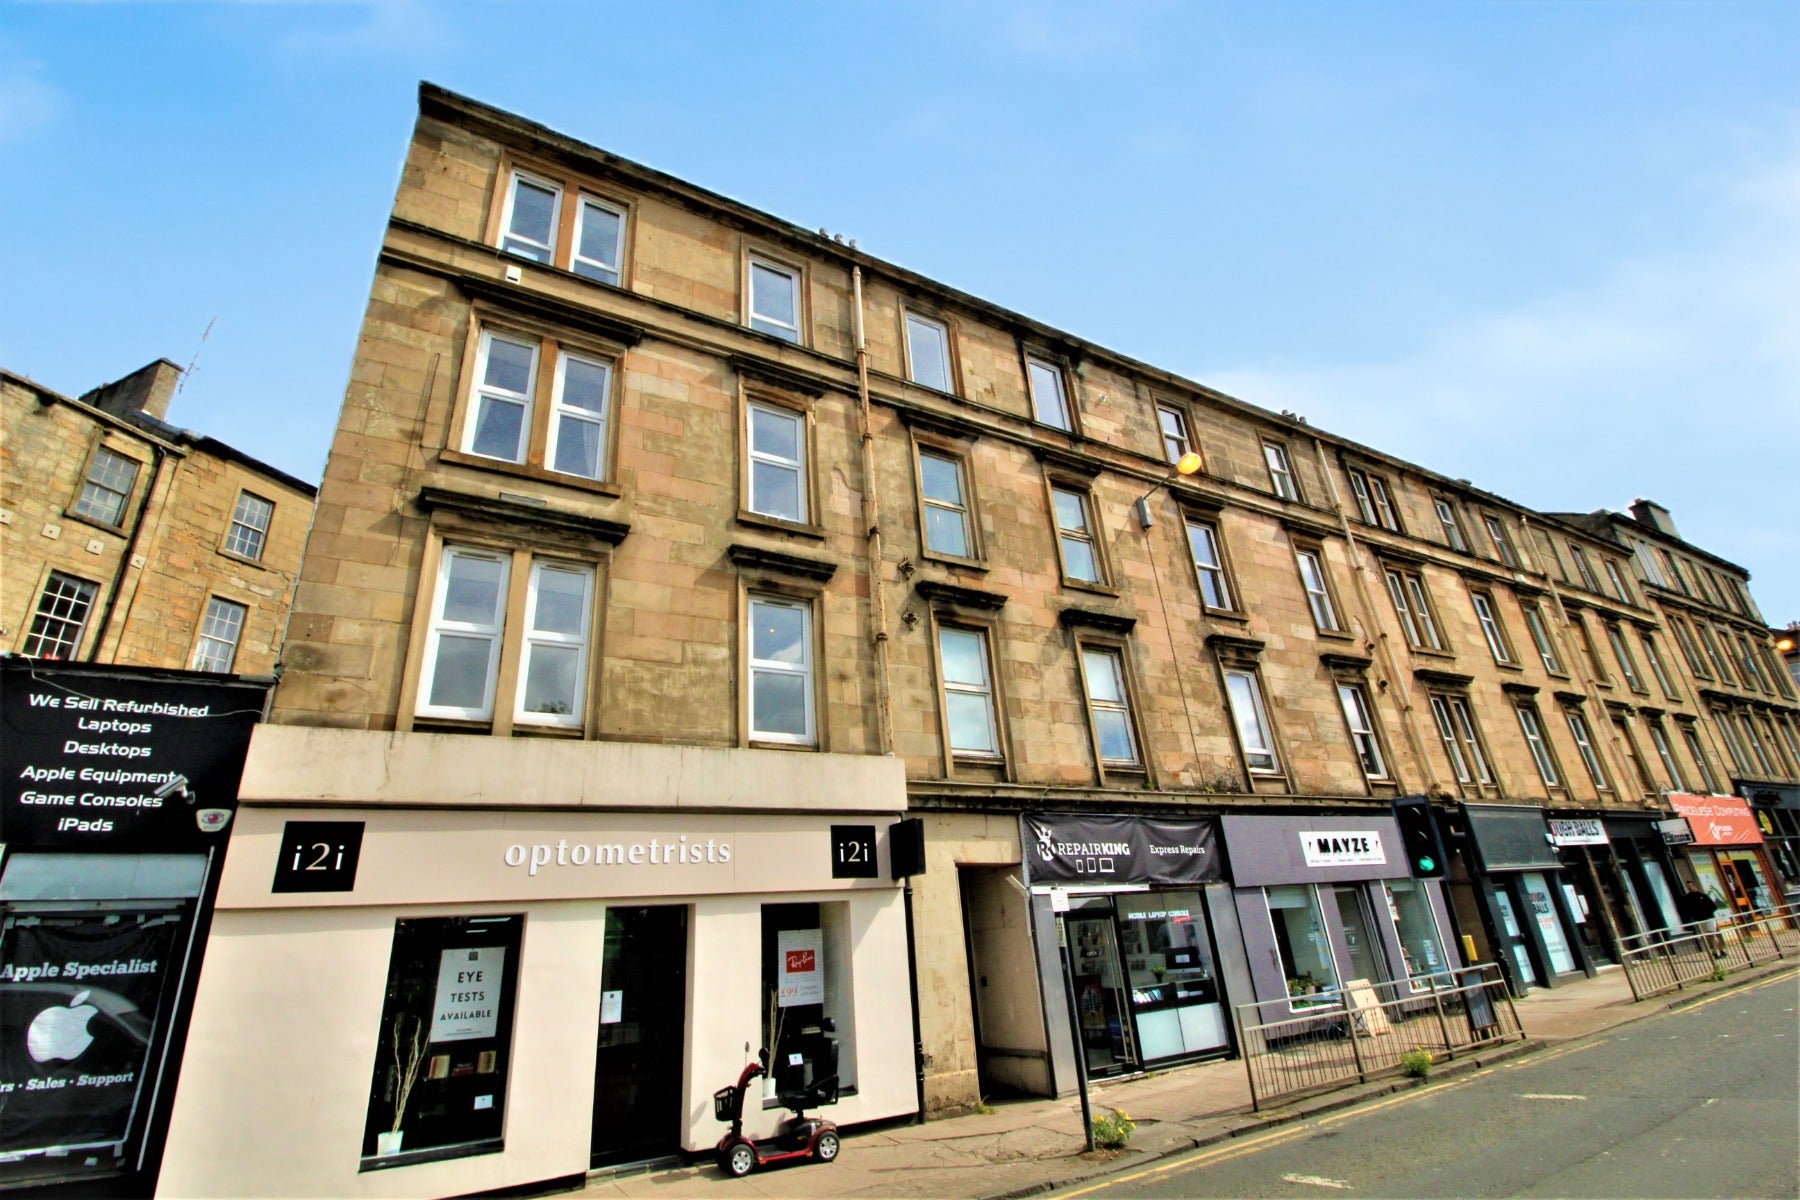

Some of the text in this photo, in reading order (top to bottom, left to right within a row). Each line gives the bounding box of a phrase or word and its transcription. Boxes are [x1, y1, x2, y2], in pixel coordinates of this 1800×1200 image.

[29, 694, 209, 717] We Sell Refurbished
[78, 717, 152, 735] Laptops
[63, 741, 152, 758] Desktops
[20, 766, 177, 784] Apple Equipment
[20, 791, 163, 808] Game Consoles
[57, 818, 113, 832] iPads
[1573, 821, 1600, 835] BALLS
[839, 841, 870, 863] i2i
[1057, 842, 1131, 856] REPAIRKING
[1149, 844, 1205, 856] Express Repairs
[1317, 838, 1370, 853] MAYZE
[292, 842, 345, 871] i2i
[504, 835, 731, 877] optometrists
[0, 959, 158, 982] Apple Specialist
[457, 970, 483, 984] EYE
[450, 991, 485, 1003] TESTS
[440, 1009, 492, 1021] AVAILABLE
[26, 1077, 67, 1091] Sales
[77, 1071, 134, 1088] Support
